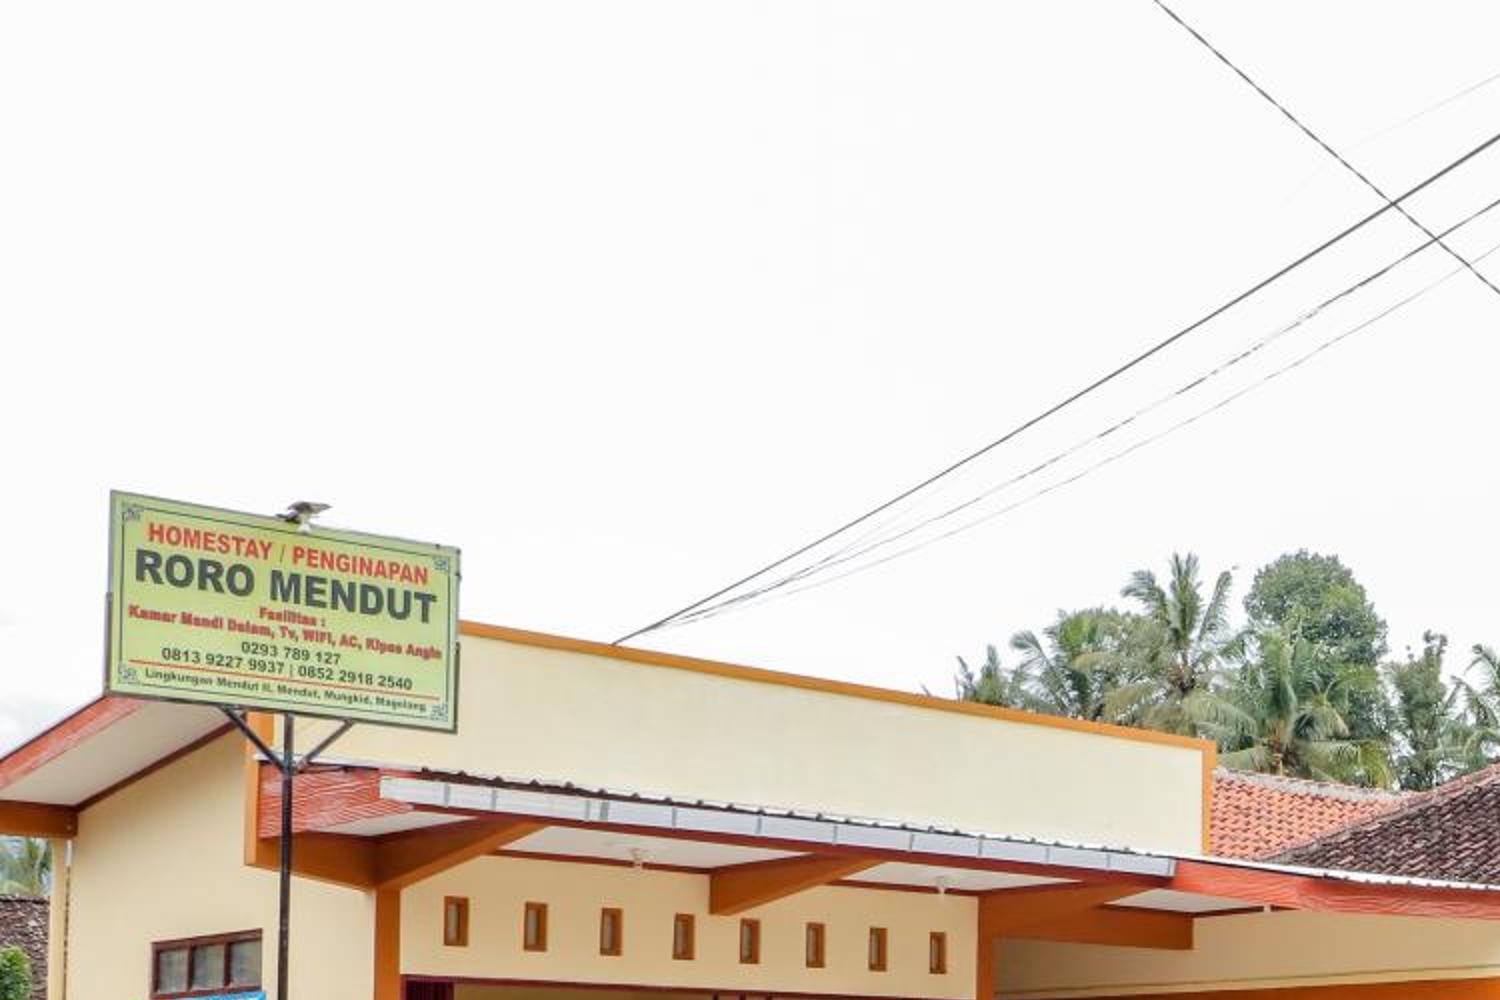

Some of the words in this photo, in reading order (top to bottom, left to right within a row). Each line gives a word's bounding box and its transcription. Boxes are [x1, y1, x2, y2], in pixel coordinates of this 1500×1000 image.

[148, 522, 273, 559] HOMESTAY
[279, 543, 287, 565] /
[293, 545, 429, 586] PENGINAPAN
[135, 548, 255, 597] RORO
[270, 569, 438, 624] MENDUT
[128, 604, 178, 623] Kamar
[181, 612, 224, 630] Mandi
[339, 633, 363, 650] AC,
[365, 637, 402, 655] Kipas
[241, 641, 278, 658] 0293
[283, 646, 310, 661] 789
[315, 651, 341, 665] 127
[145, 667, 213, 686] Lingkungan
[217, 676, 259, 691] Mendut
[161, 647, 200, 664] 0813
[205, 652, 243, 669] 9227
[248, 658, 285, 675] 9937
[298, 665, 334, 681] 0852
[338, 669, 373, 685] 2918
[377, 675, 413, 690] 2540
